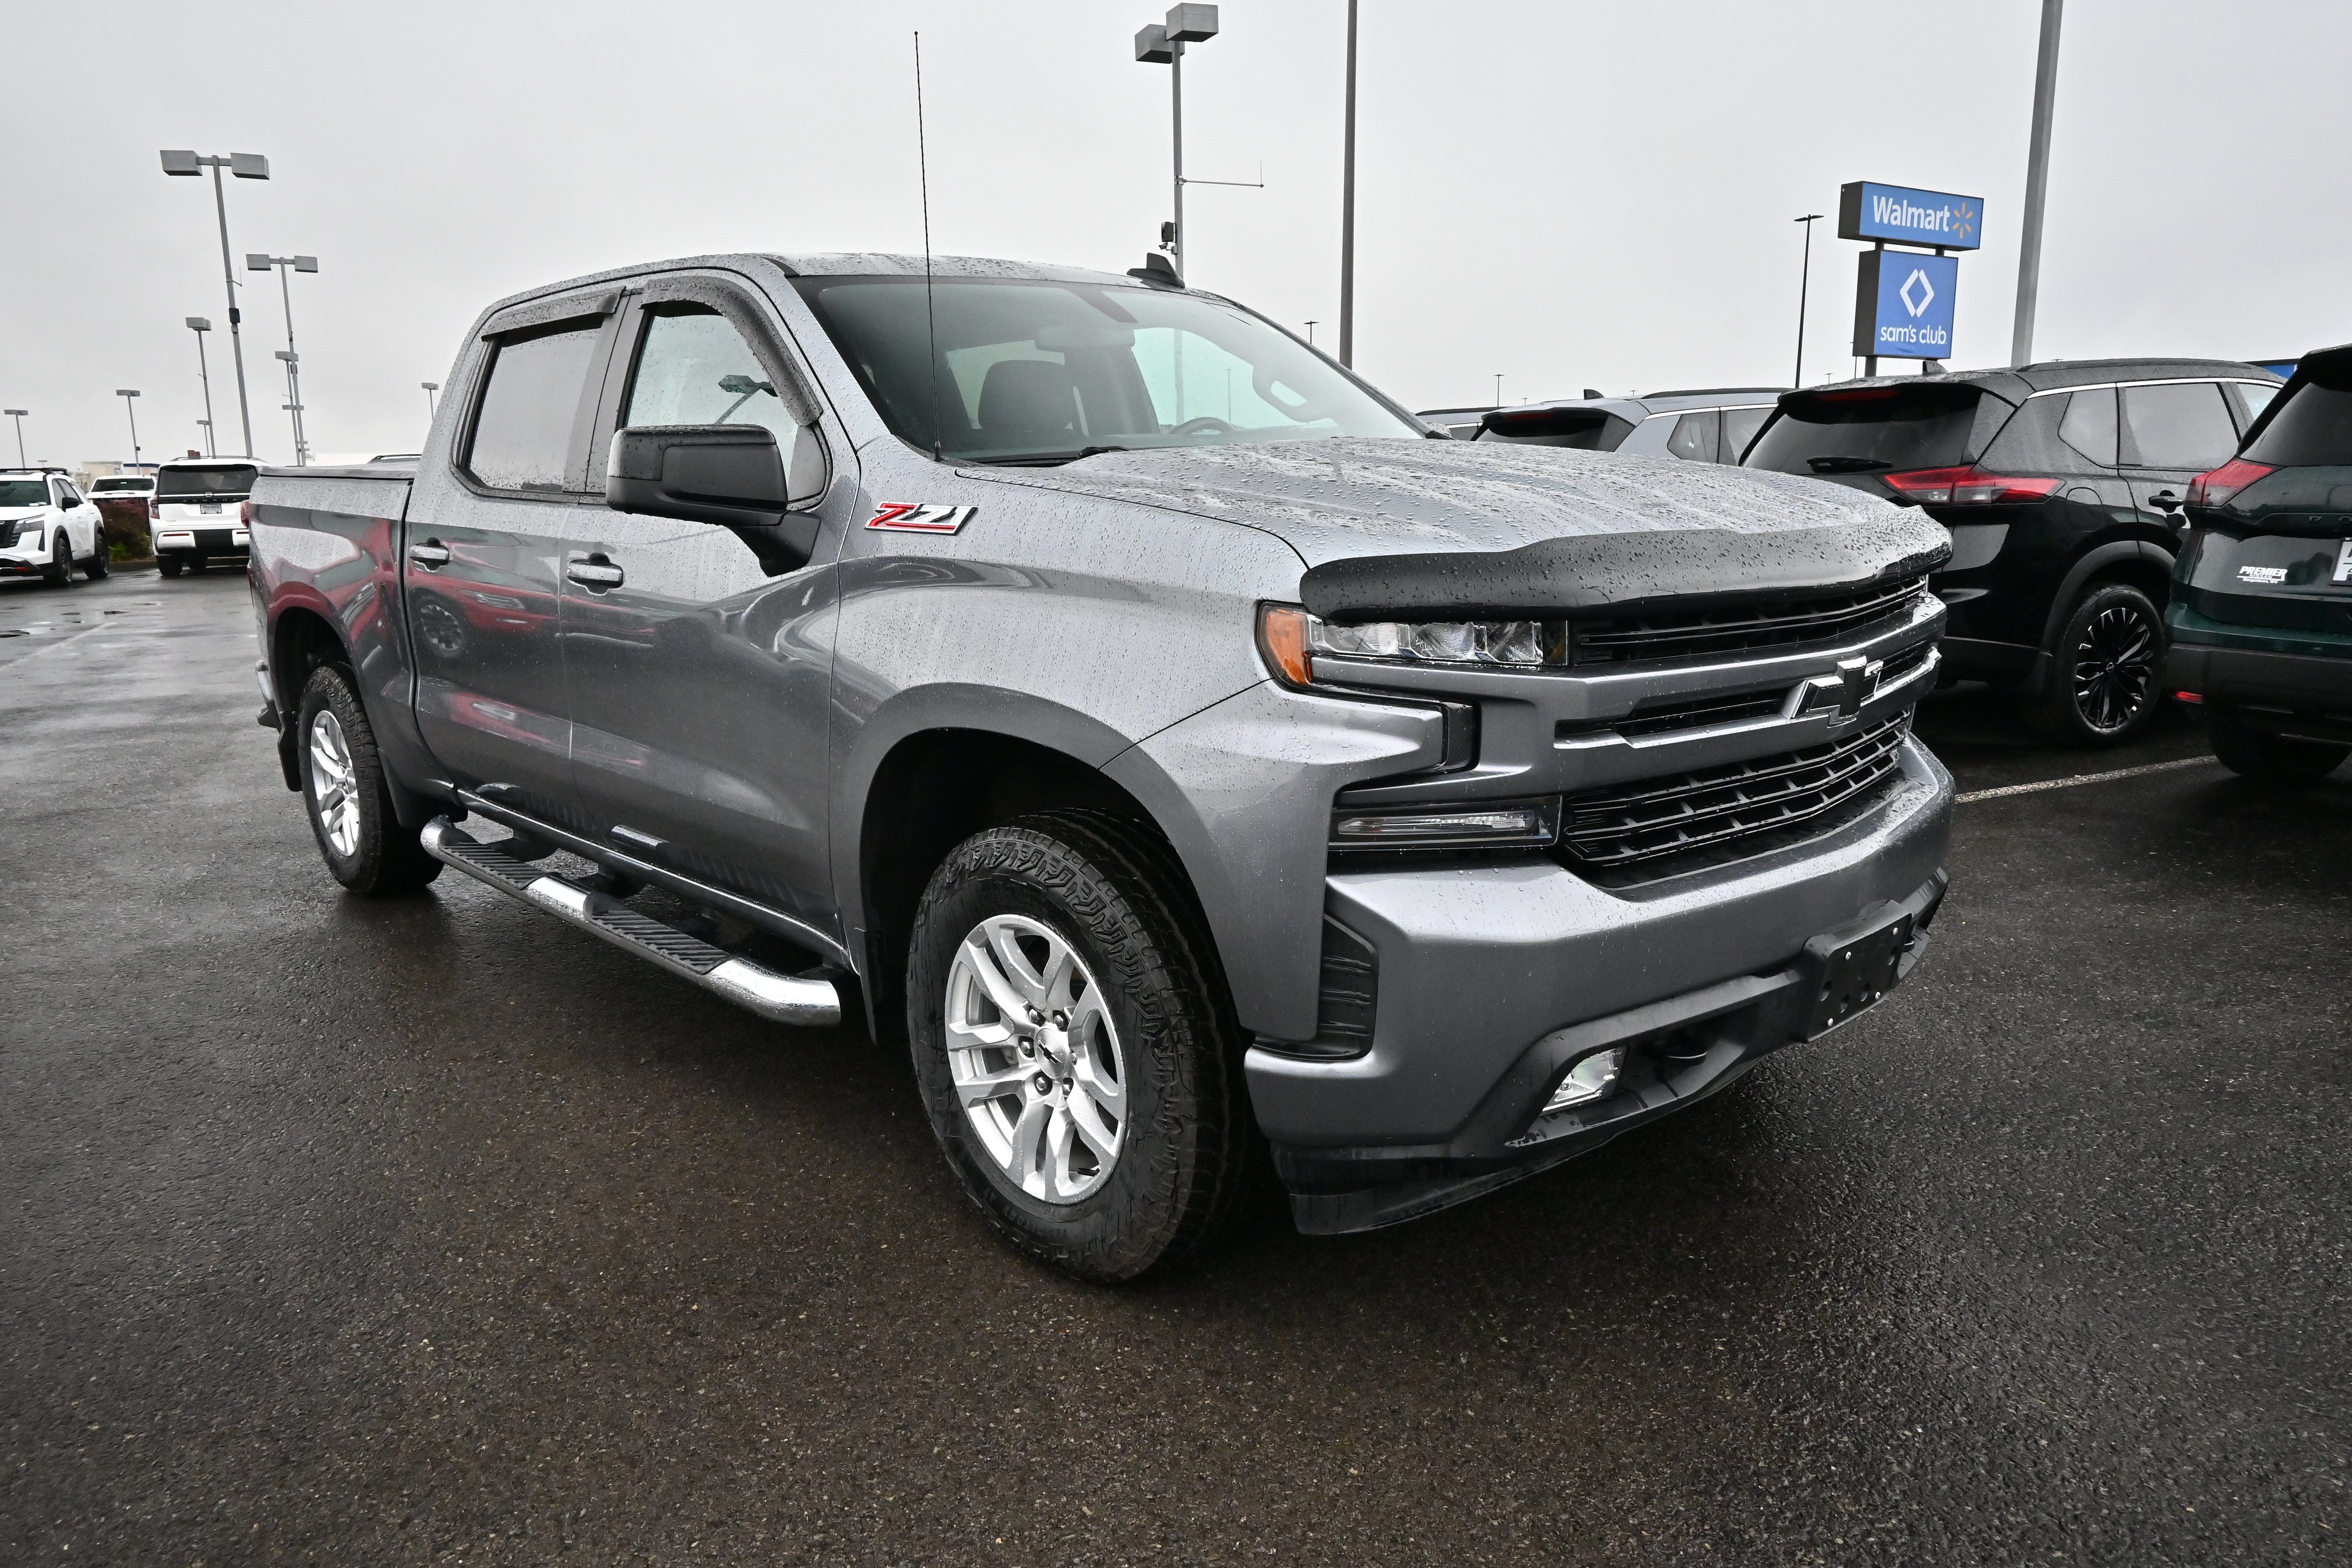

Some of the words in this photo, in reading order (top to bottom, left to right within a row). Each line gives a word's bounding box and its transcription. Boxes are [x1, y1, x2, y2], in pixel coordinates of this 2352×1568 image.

[1873, 195, 1950, 231] Walmart
[1881, 324, 1916, 343] sam's
[1919, 324, 1946, 345] club
[864, 501, 978, 536] Z71
[2239, 566, 2288, 577] PREMIER
